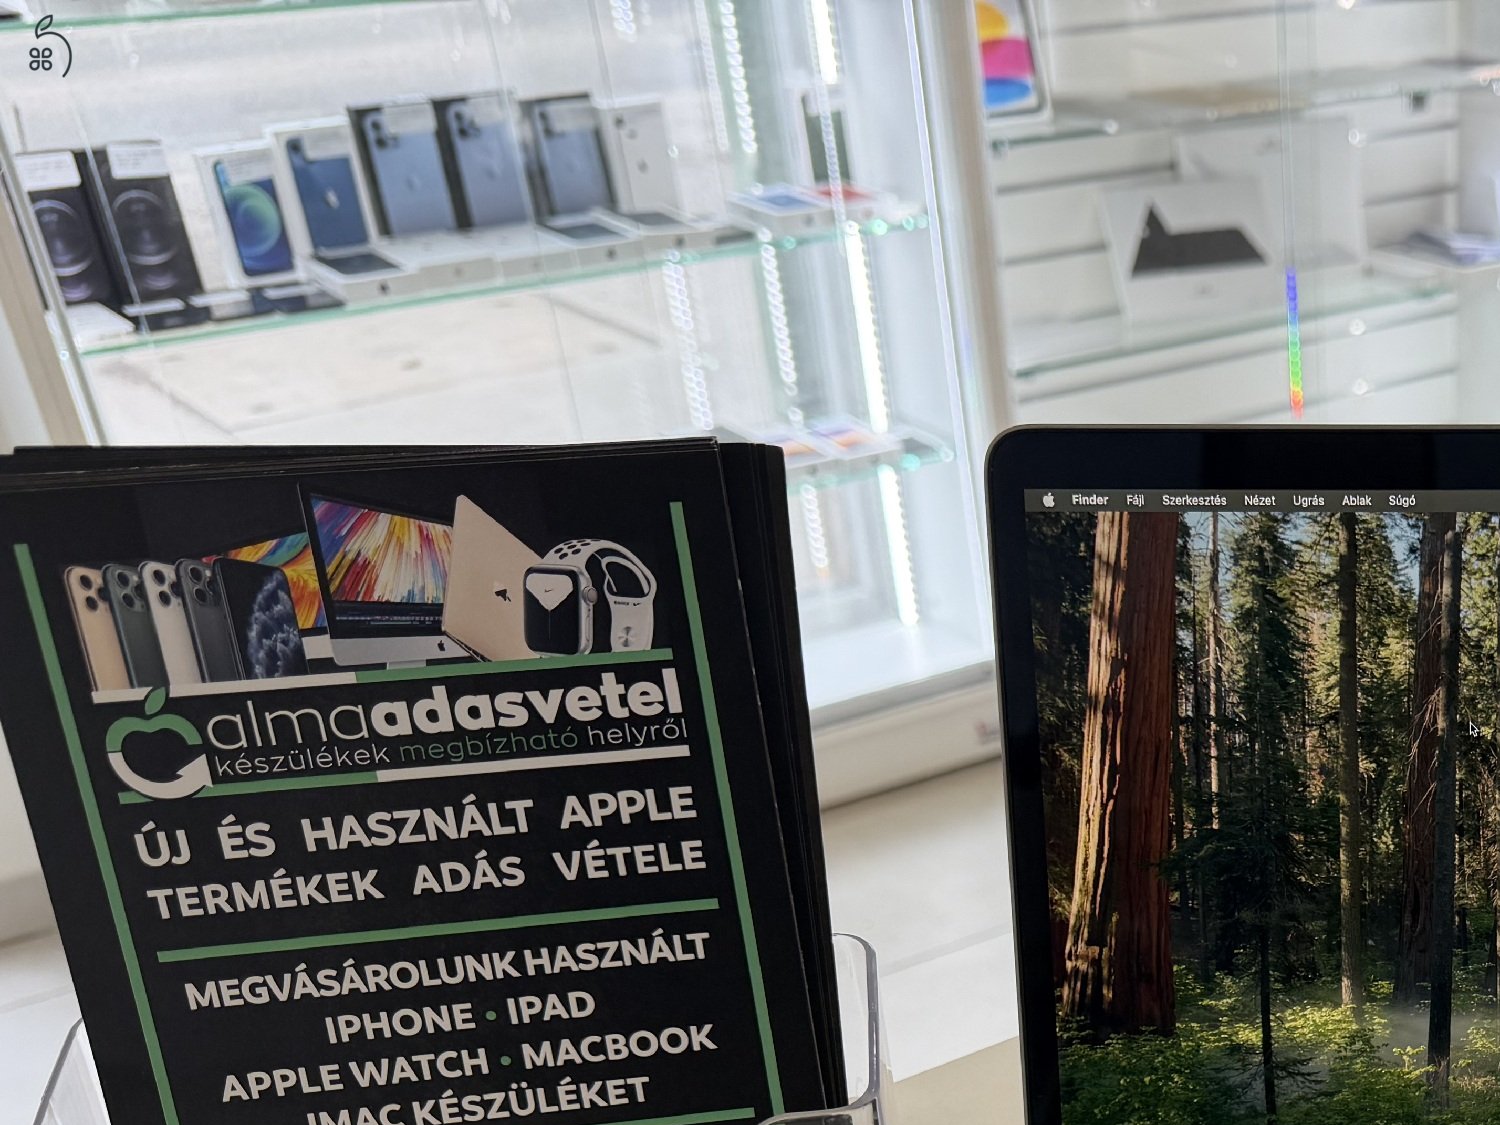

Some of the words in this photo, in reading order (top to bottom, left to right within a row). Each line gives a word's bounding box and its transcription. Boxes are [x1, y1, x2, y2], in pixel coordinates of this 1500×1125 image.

[1071, 493, 1109, 507] Finder
[1126, 493, 1145, 508] Fájl
[1161, 493, 1227, 507] Szerkesztés
[1243, 493, 1276, 507] Nézet
[1292, 493, 1325, 508] Ugrás
[1341, 493, 1372, 507] Ablak
[1388, 493, 1416, 508] Súgó
[206, 668, 683, 750] almaadasvetel
[214, 744, 391, 777] készülékek
[400, 727, 579, 763] megbízható
[587, 718, 688, 746] helyről
[133, 820, 191, 867] ÚJ
[217, 813, 276, 860] ÉS
[300, 794, 534, 852] HASZNÁLT
[560, 786, 698, 829] APPLE
[146, 867, 385, 920] TERMÉKEK
[412, 849, 526, 896] ADÁS
[552, 838, 707, 881] VÉTELE
[184, 958, 522, 1011] MEGVÁSÁROLUNK
[523, 927, 710, 976] HASZNÁLT
[325, 1002, 476, 1044] IPHONE
[506, 991, 596, 1025] IPAD
[222, 1063, 345, 1103] APPLE
[348, 1047, 490, 1088] WATCH
[521, 1023, 719, 1070] MACBOOK
